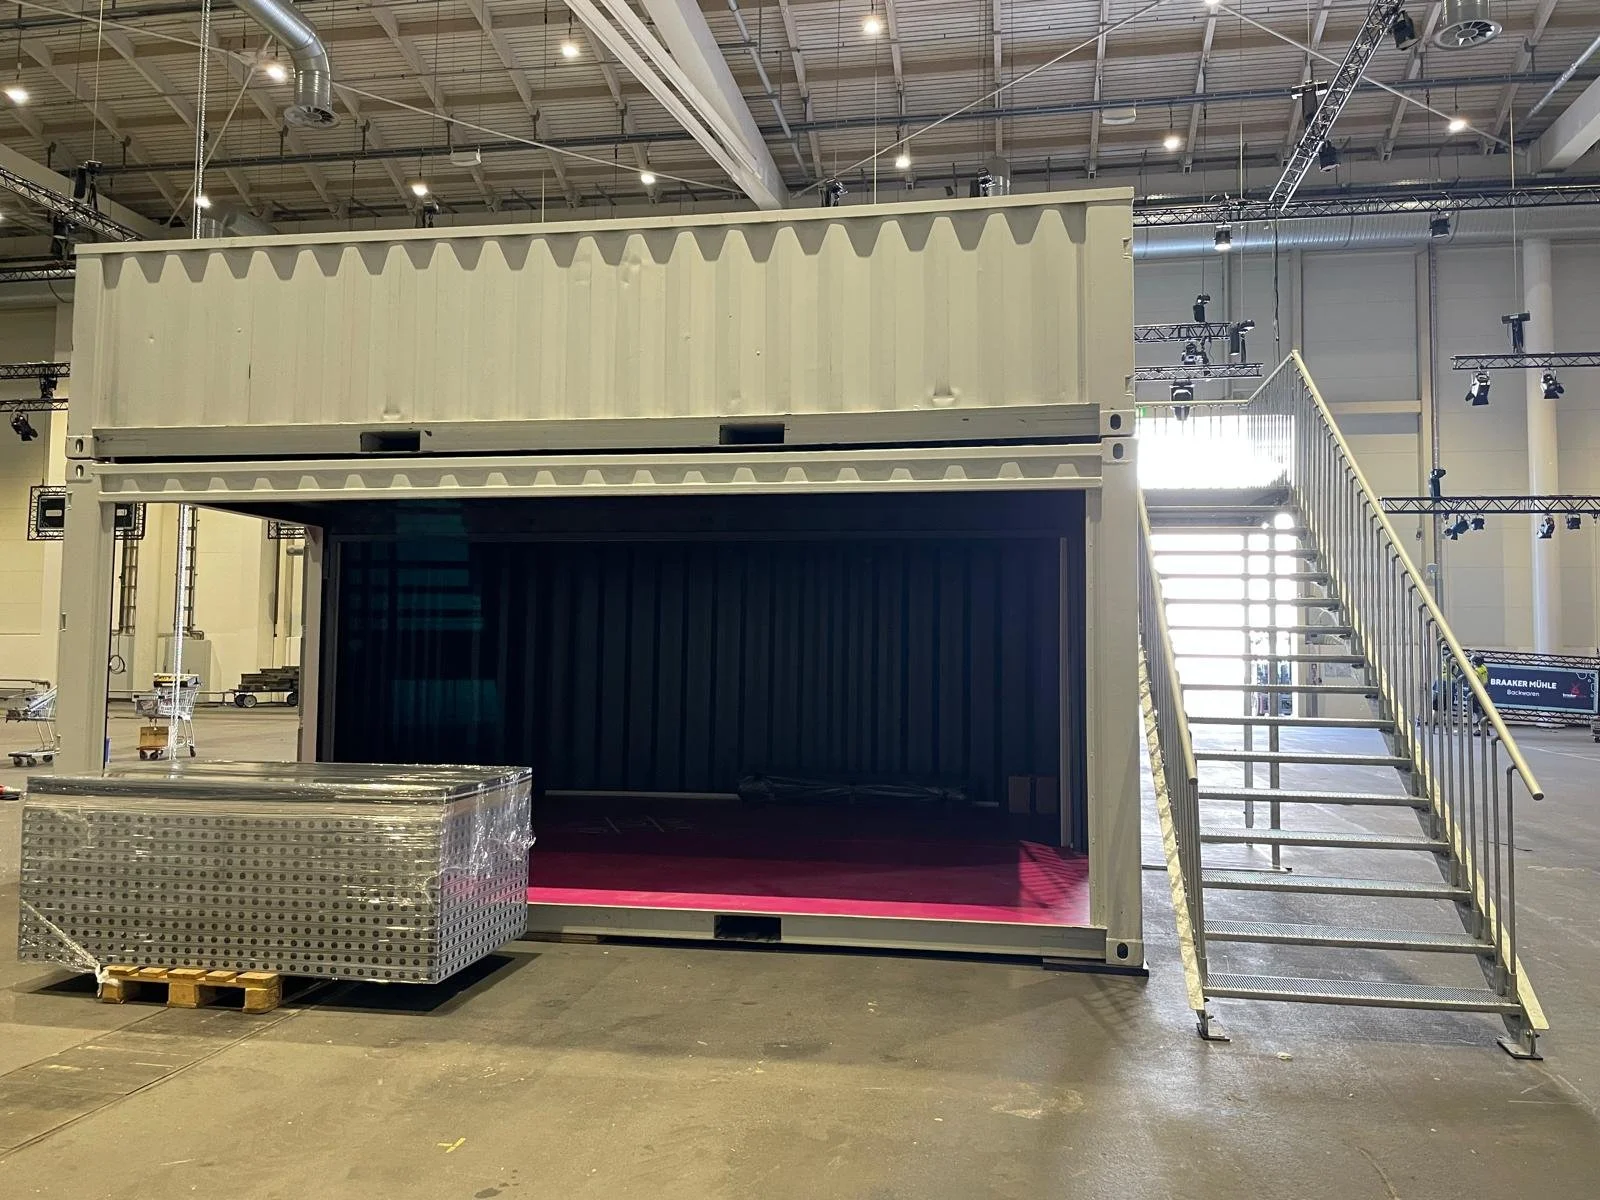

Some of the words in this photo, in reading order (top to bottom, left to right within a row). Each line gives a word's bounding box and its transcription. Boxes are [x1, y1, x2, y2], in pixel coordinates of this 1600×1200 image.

[1490, 678, 1528, 688] BRAAKER
[1529, 679, 1557, 689] MÜHLE
[1506, 689, 1540, 697] Backwaren
